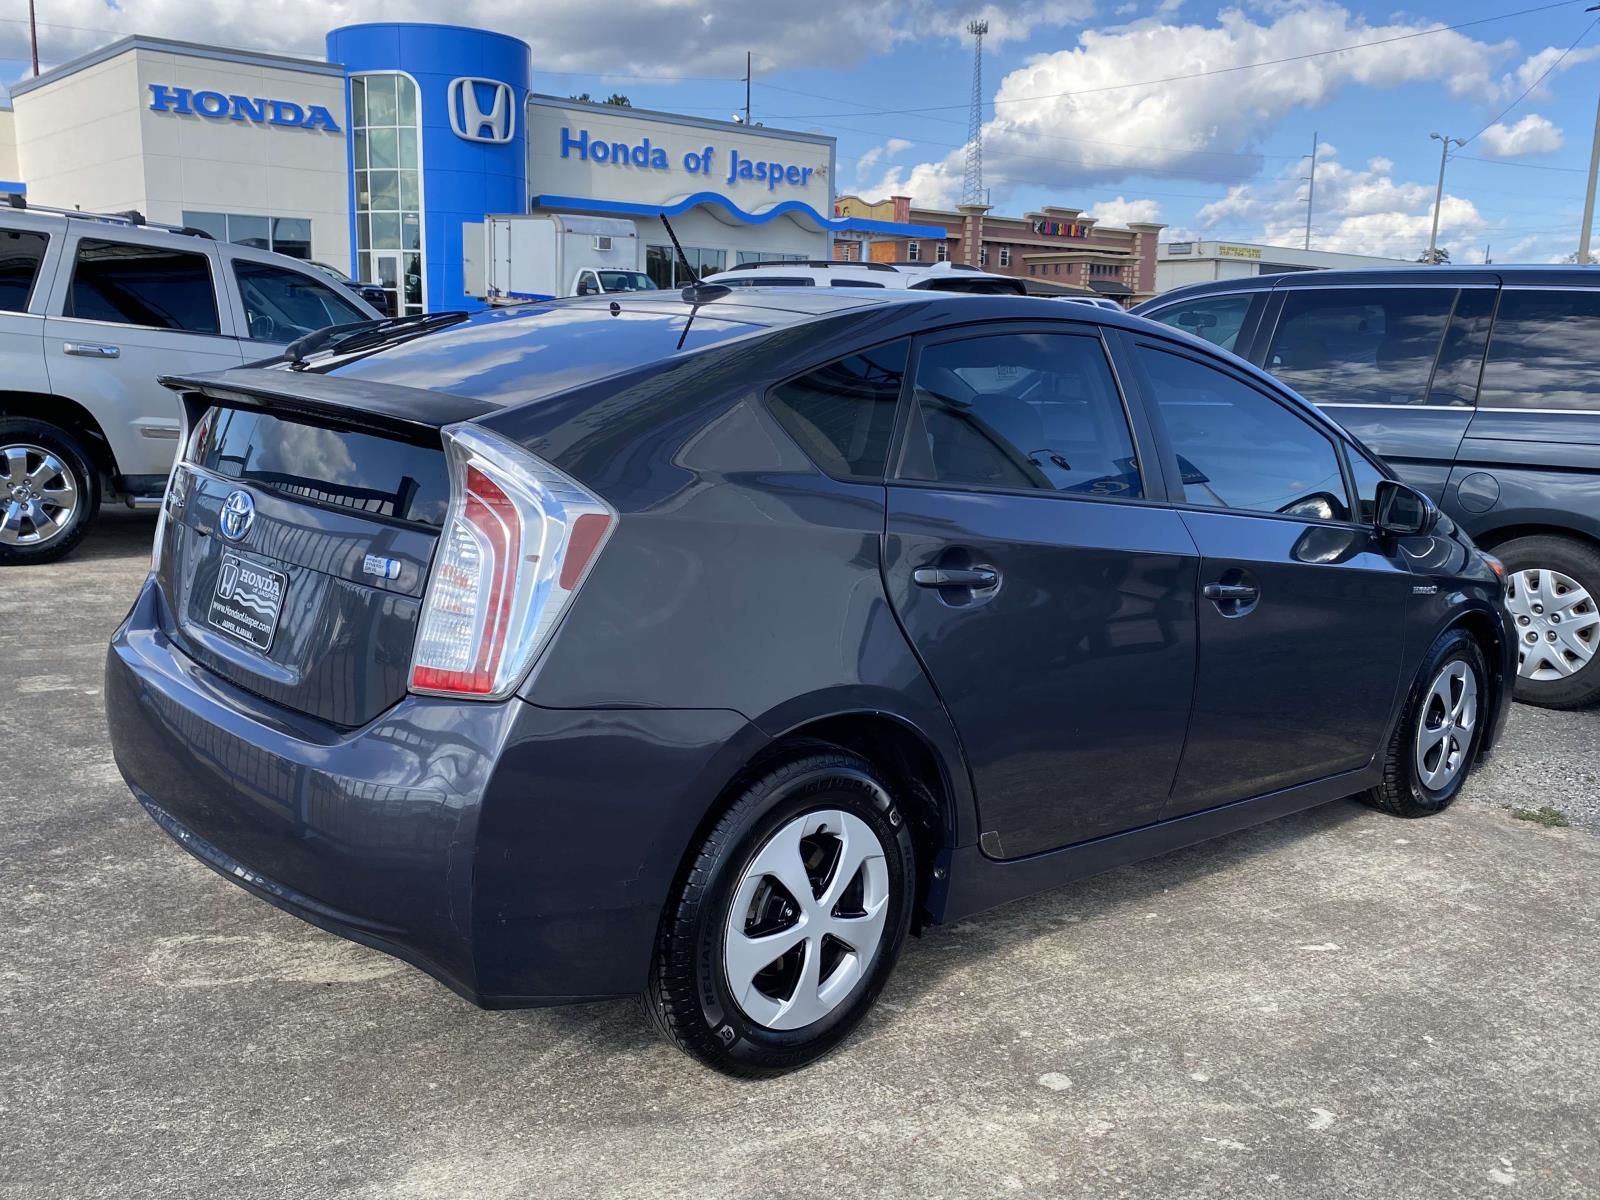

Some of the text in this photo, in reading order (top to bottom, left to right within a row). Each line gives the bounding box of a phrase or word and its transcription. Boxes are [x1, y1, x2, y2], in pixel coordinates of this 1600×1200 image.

[149, 84, 341, 132] HONDA
[560, 127, 814, 191] Honda of Jasper
[239, 568, 280, 596] HONDA
[257, 589, 279, 602] JASPER
[236, 625, 253, 639] ALABAMA
